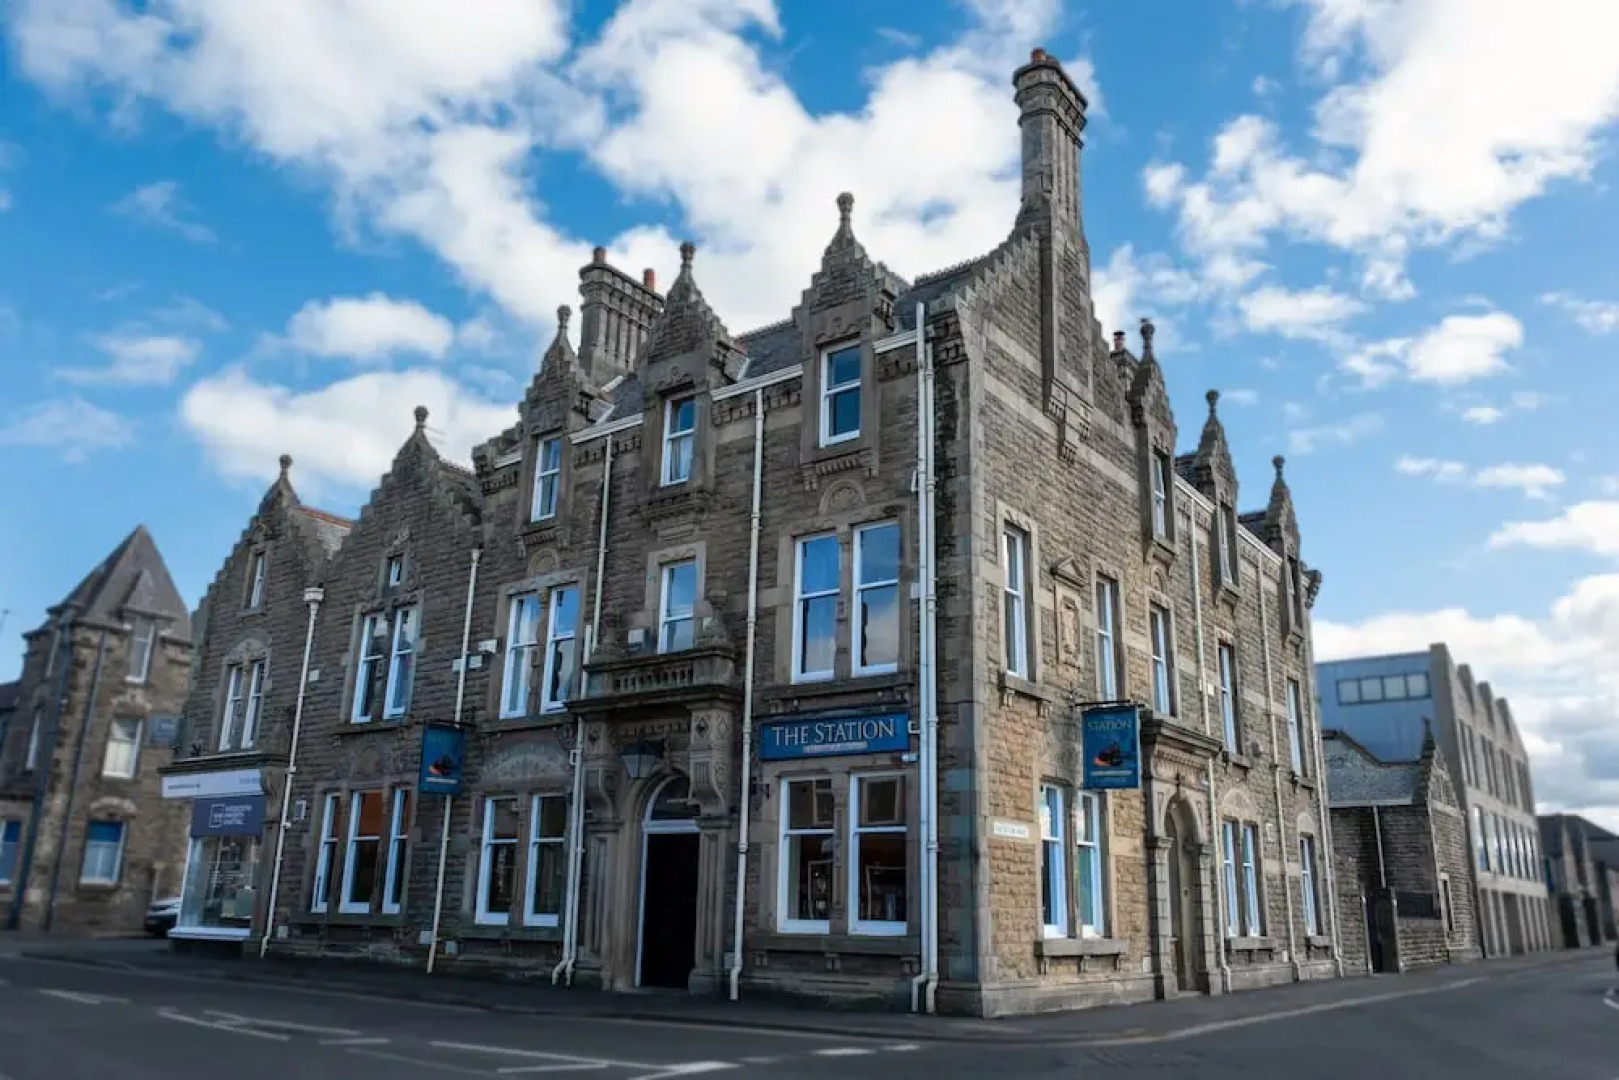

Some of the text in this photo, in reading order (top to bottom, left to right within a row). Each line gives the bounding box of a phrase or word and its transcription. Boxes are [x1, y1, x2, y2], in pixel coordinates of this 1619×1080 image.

[772, 718, 895, 746] THE STATION
[1088, 719, 1133, 732] STATION
